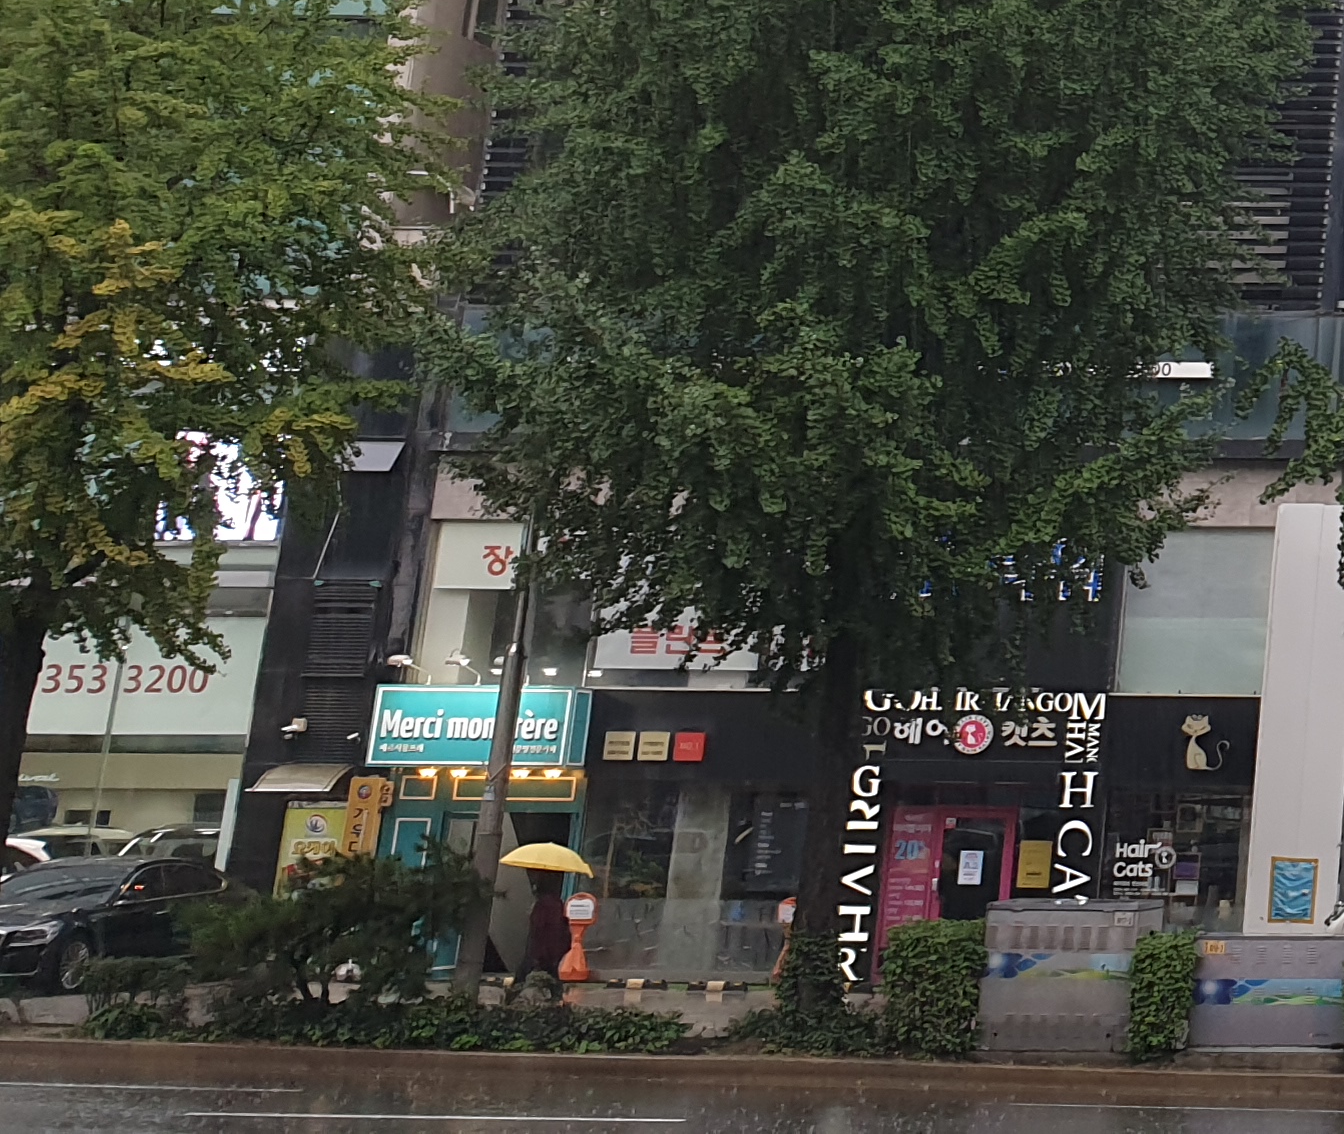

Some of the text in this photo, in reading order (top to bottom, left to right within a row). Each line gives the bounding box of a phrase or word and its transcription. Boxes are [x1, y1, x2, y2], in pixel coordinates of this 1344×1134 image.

[41, 663, 210, 694] 353 3200
[379, 709, 444, 740] Merci
[508, 708, 559, 741] rère
[1114, 838, 1163, 859] Hair
[1112, 860, 1154, 878] Cats
